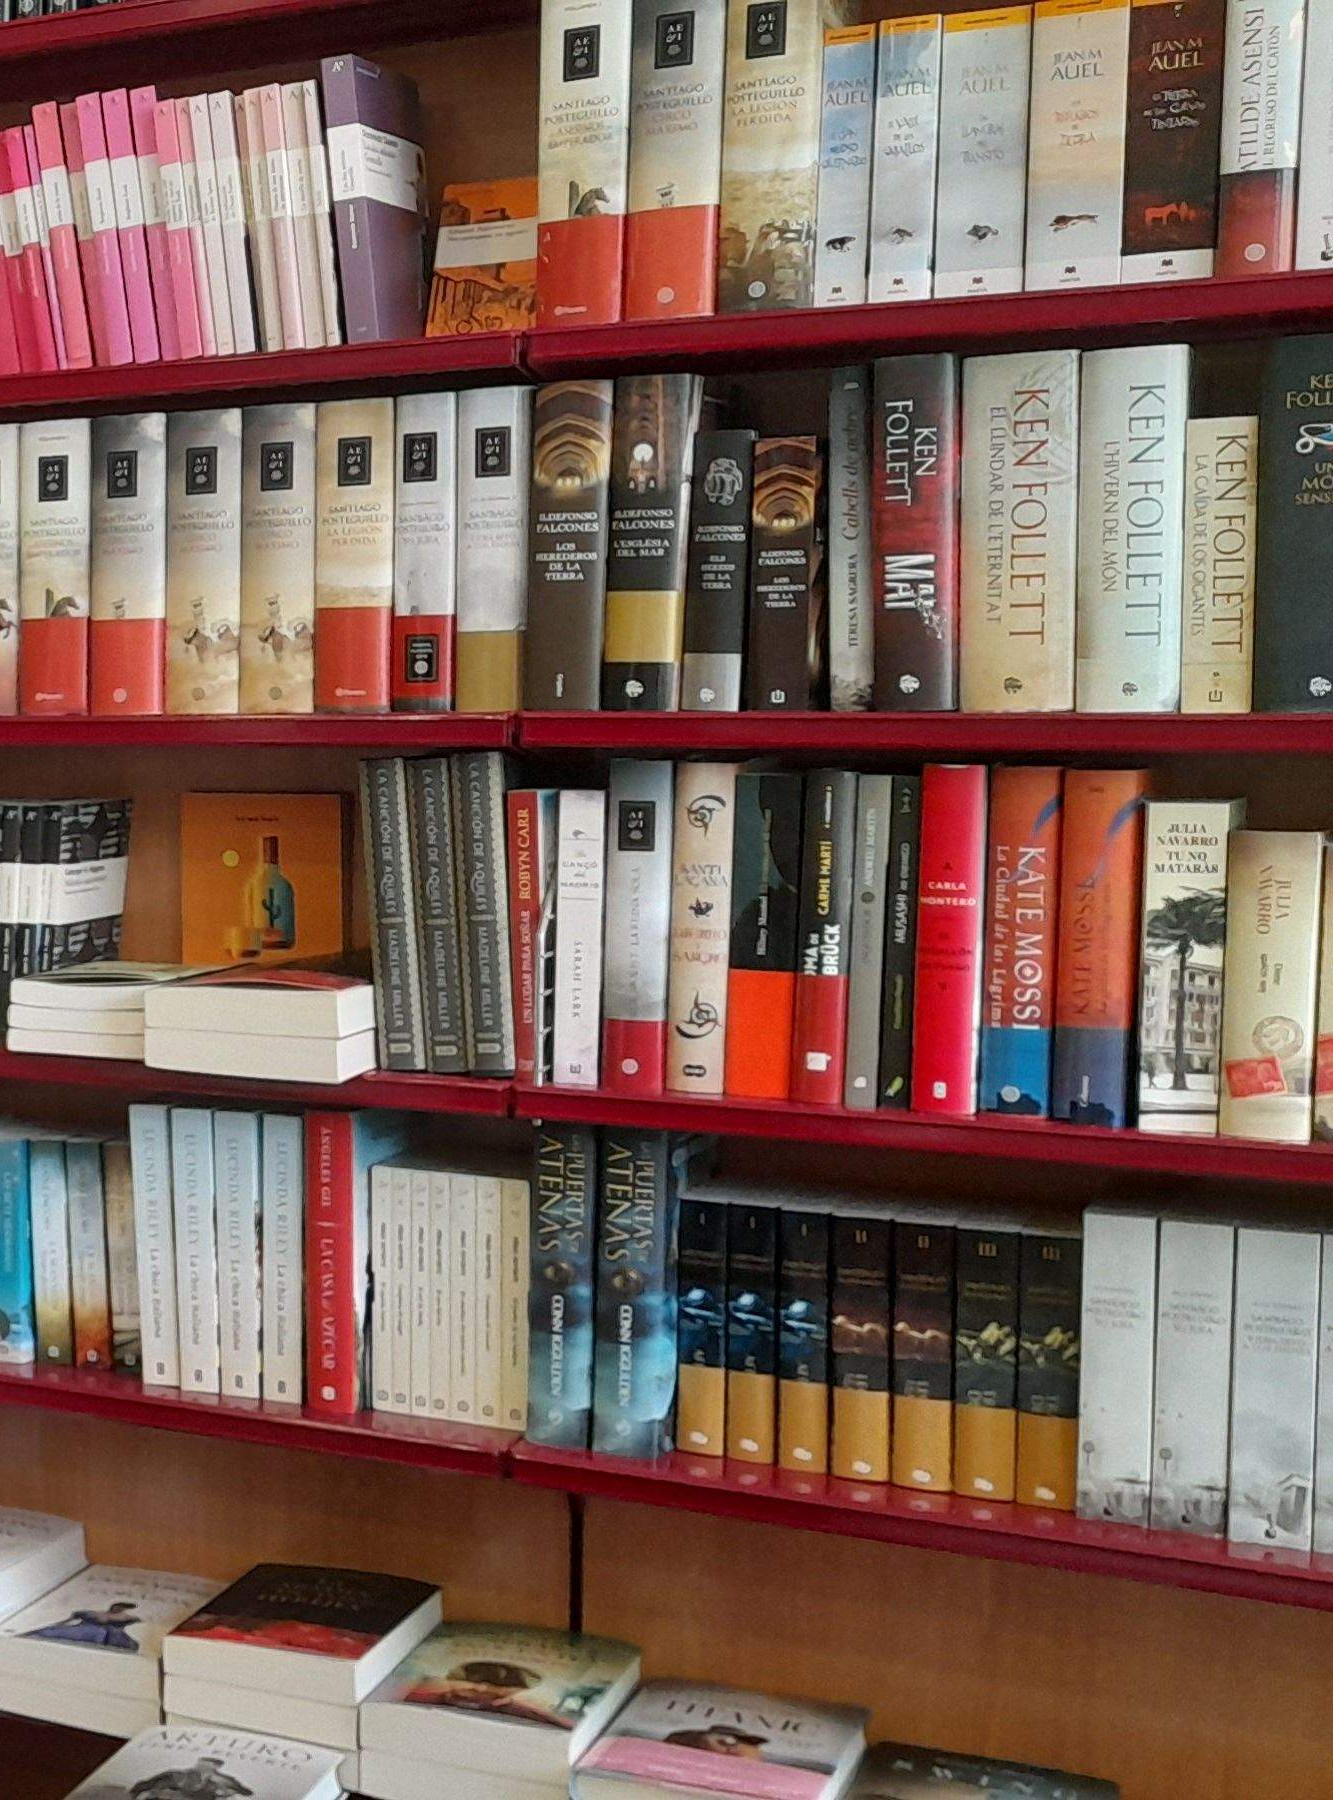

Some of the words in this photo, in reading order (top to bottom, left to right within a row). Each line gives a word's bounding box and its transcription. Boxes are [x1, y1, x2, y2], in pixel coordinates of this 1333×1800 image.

[1148, 52, 1205, 71] AUEL
[1241, 8, 1265, 87] ASENSI
[1050, 62, 1104, 81] AUEL
[1238, 96, 1262, 170] ATILDE
[1310, 374, 1333, 389] KE
[1012, 388, 1051, 468] KEN
[1128, 384, 1166, 465] KEN
[885, 399, 913, 506] FOLLETT
[914, 427, 938, 477] KEN
[1193, 455, 1209, 474] LA
[1214, 435, 1249, 501] KEN
[1102, 441, 1119, 513] L'HIVERN
[536, 522, 599, 533] FALCONES
[612, 519, 675, 530] FALCONES
[842, 480, 860, 541] Cabells
[988, 500, 1005, 519] DE
[555, 542, 576, 552] LOS
[1102, 518, 1118, 546] DEL
[1192, 523, 1207, 539] DE
[535, 552, 598, 561] HEREDEROS
[549, 562, 564, 571] DE
[565, 562, 581, 571] LA
[616, 549, 636, 557] DEL
[639, 548, 665, 557] MAR
[1008, 482, 1048, 645] FOLLETT
[1101, 551, 1118, 593] MÓN
[1124, 479, 1164, 647] FOLLETT
[1191, 541, 1207, 568] LOS
[545, 571, 584, 581] TIERRA
[1211, 514, 1246, 653] FOLLETT
[1190, 571, 1206, 637] GIGANTES
[848, 607, 859, 648] TERESA
[517, 808, 530, 848] CARR
[1156, 836, 1219, 847] NAVARRO
[1167, 824, 1207, 834] JULIA
[518, 850, 533, 900] ROBYN
[928, 881, 967, 891] CARLA
[1014, 846, 1046, 924] KATE
[919, 897, 977, 907] MONTERO
[821, 923, 841, 976] BRÜCK
[538, 1136, 564, 1251] ATENAS
[605, 1143, 633, 1262] ATENAS
